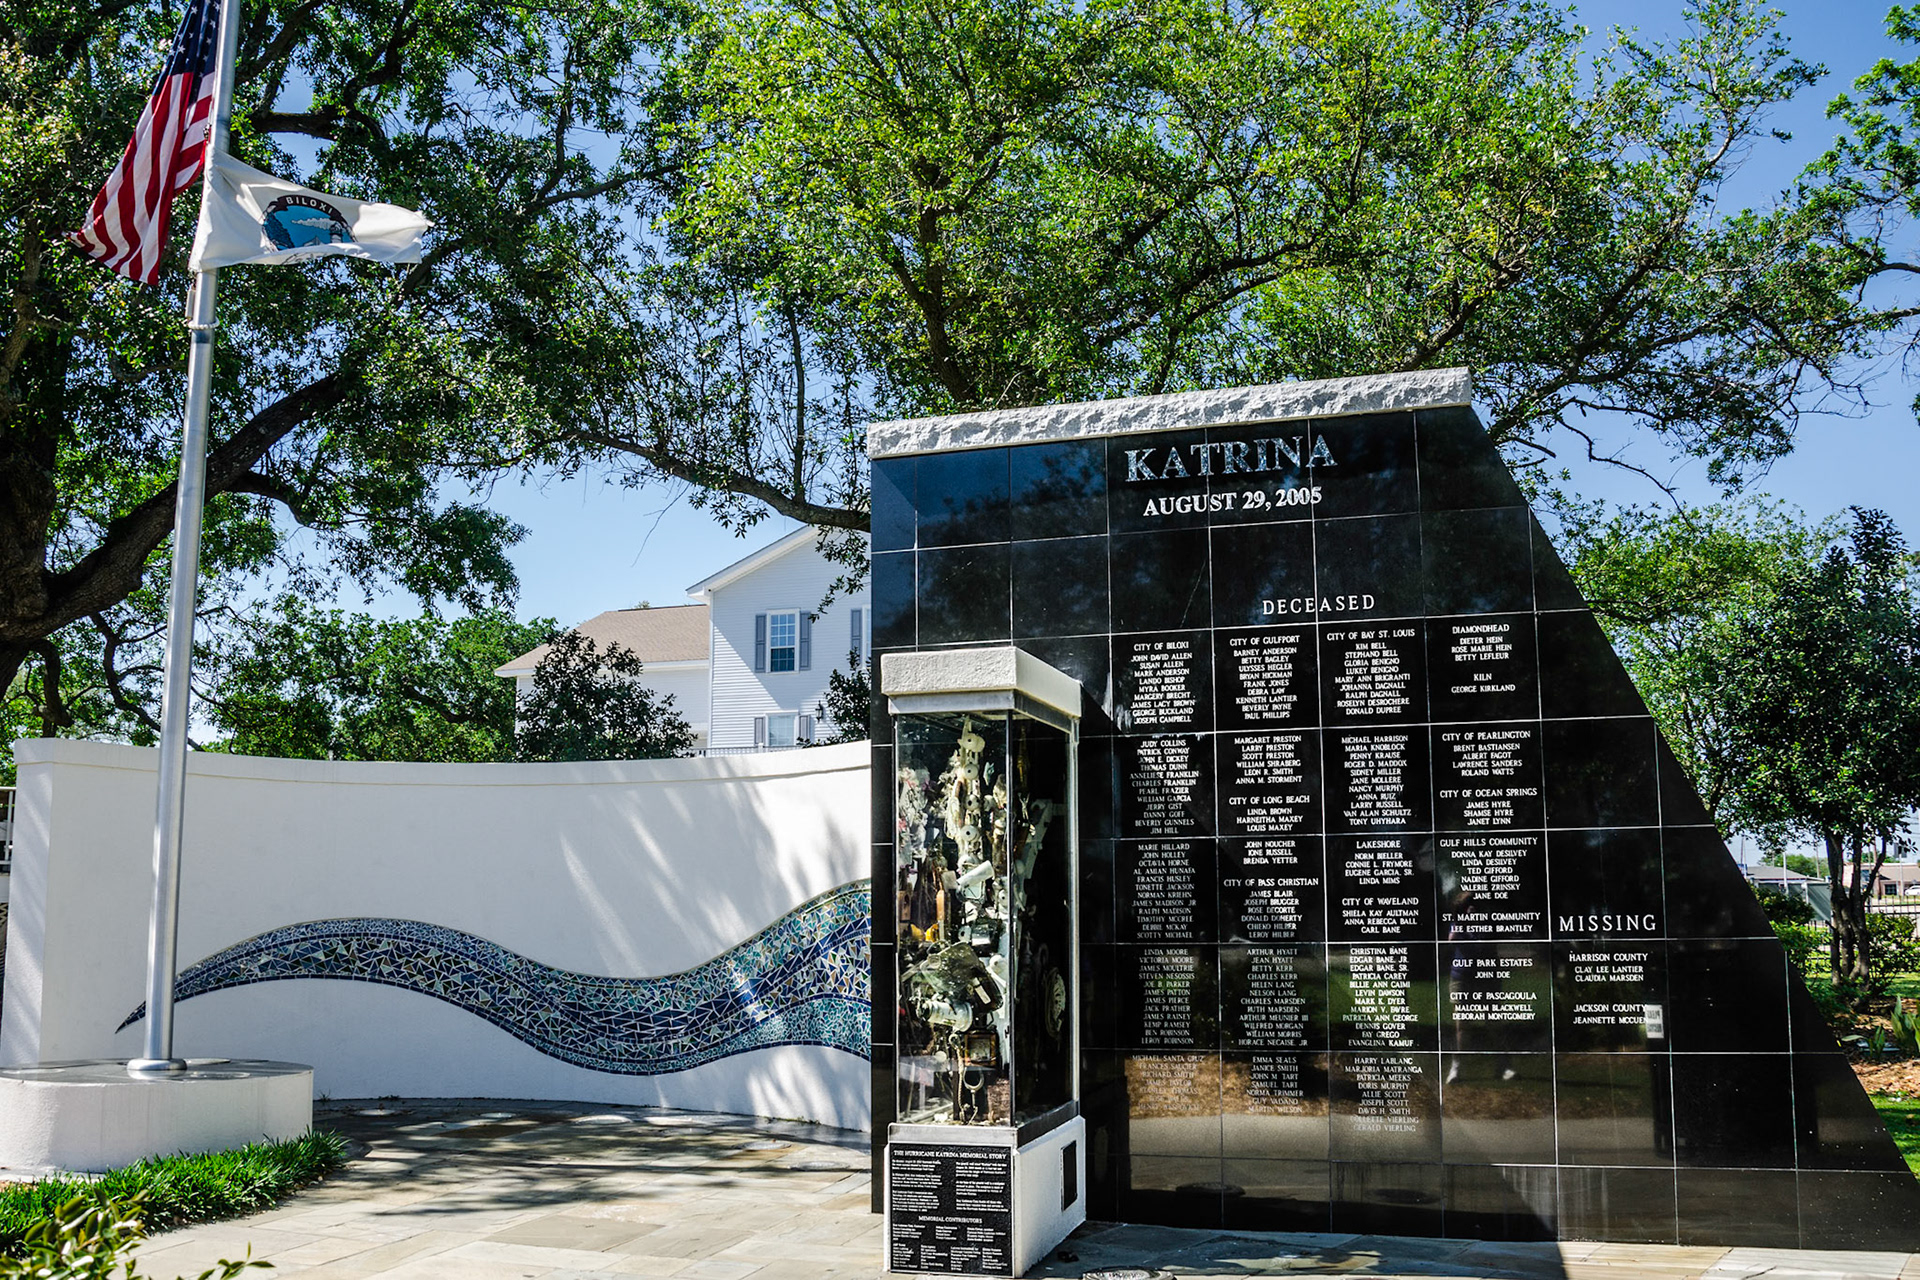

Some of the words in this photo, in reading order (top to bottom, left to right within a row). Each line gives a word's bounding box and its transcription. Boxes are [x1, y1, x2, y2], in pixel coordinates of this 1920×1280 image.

[286, 197, 333, 214] BILOXI
[1124, 434, 1337, 482] KATRINA
[1143, 493, 1237, 516] AUGUST
[1242, 491, 1272, 512] 29,
[1275, 486, 1322, 507] 2005
[1263, 594, 1375, 615] DECEASED
[1452, 624, 1509, 634] DIAMONDHEAD
[1349, 632, 1358, 640] OF
[1361, 631, 1375, 639] BAY
[1379, 630, 1390, 638] ST.
[1393, 629, 1415, 637] LOUIS
[1263, 635, 1300, 644] GULFPORT
[1486, 636, 1503, 644] HEIN
[1263, 647, 1297, 655] ANDERSON
[1474, 673, 1492, 681] KILN
[1480, 684, 1515, 692] KIRKLAND
[1442, 733, 1460, 741] CITY
[1478, 731, 1530, 740] PEARLINGTON
[1440, 790, 1459, 798] CITY
[1476, 789, 1503, 797] OCEAN
[1506, 788, 1537, 796] SPRINGS
[1229, 797, 1247, 805] CITY
[1263, 796, 1282, 804] LONG
[1467, 818, 1490, 826] JANET
[1357, 841, 1401, 849] LAKESHORE
[1440, 839, 1460, 847] GULF
[1464, 838, 1486, 846] HILLS
[1489, 838, 1538, 846] COMMUNITY
[1278, 878, 1318, 886] CHRISTIAN
[1342, 898, 1360, 906] CITY
[1458, 913, 1488, 921] MARTIN
[1559, 914, 1656, 932] MISSING
[1569, 954, 1610, 962] HARRISON
[1614, 953, 1648, 961] COUNTY
[1477, 959, 1496, 967] PARK
[1610, 974, 1644, 982] MARSDEN
[1450, 992, 1469, 1000] CITY
[1473, 992, 1482, 1000] OF
[1486, 992, 1536, 1000] PASCAGOULA
[1573, 1004, 1609, 1012] JACKSON
[1613, 1004, 1646, 1012] COUNTY
